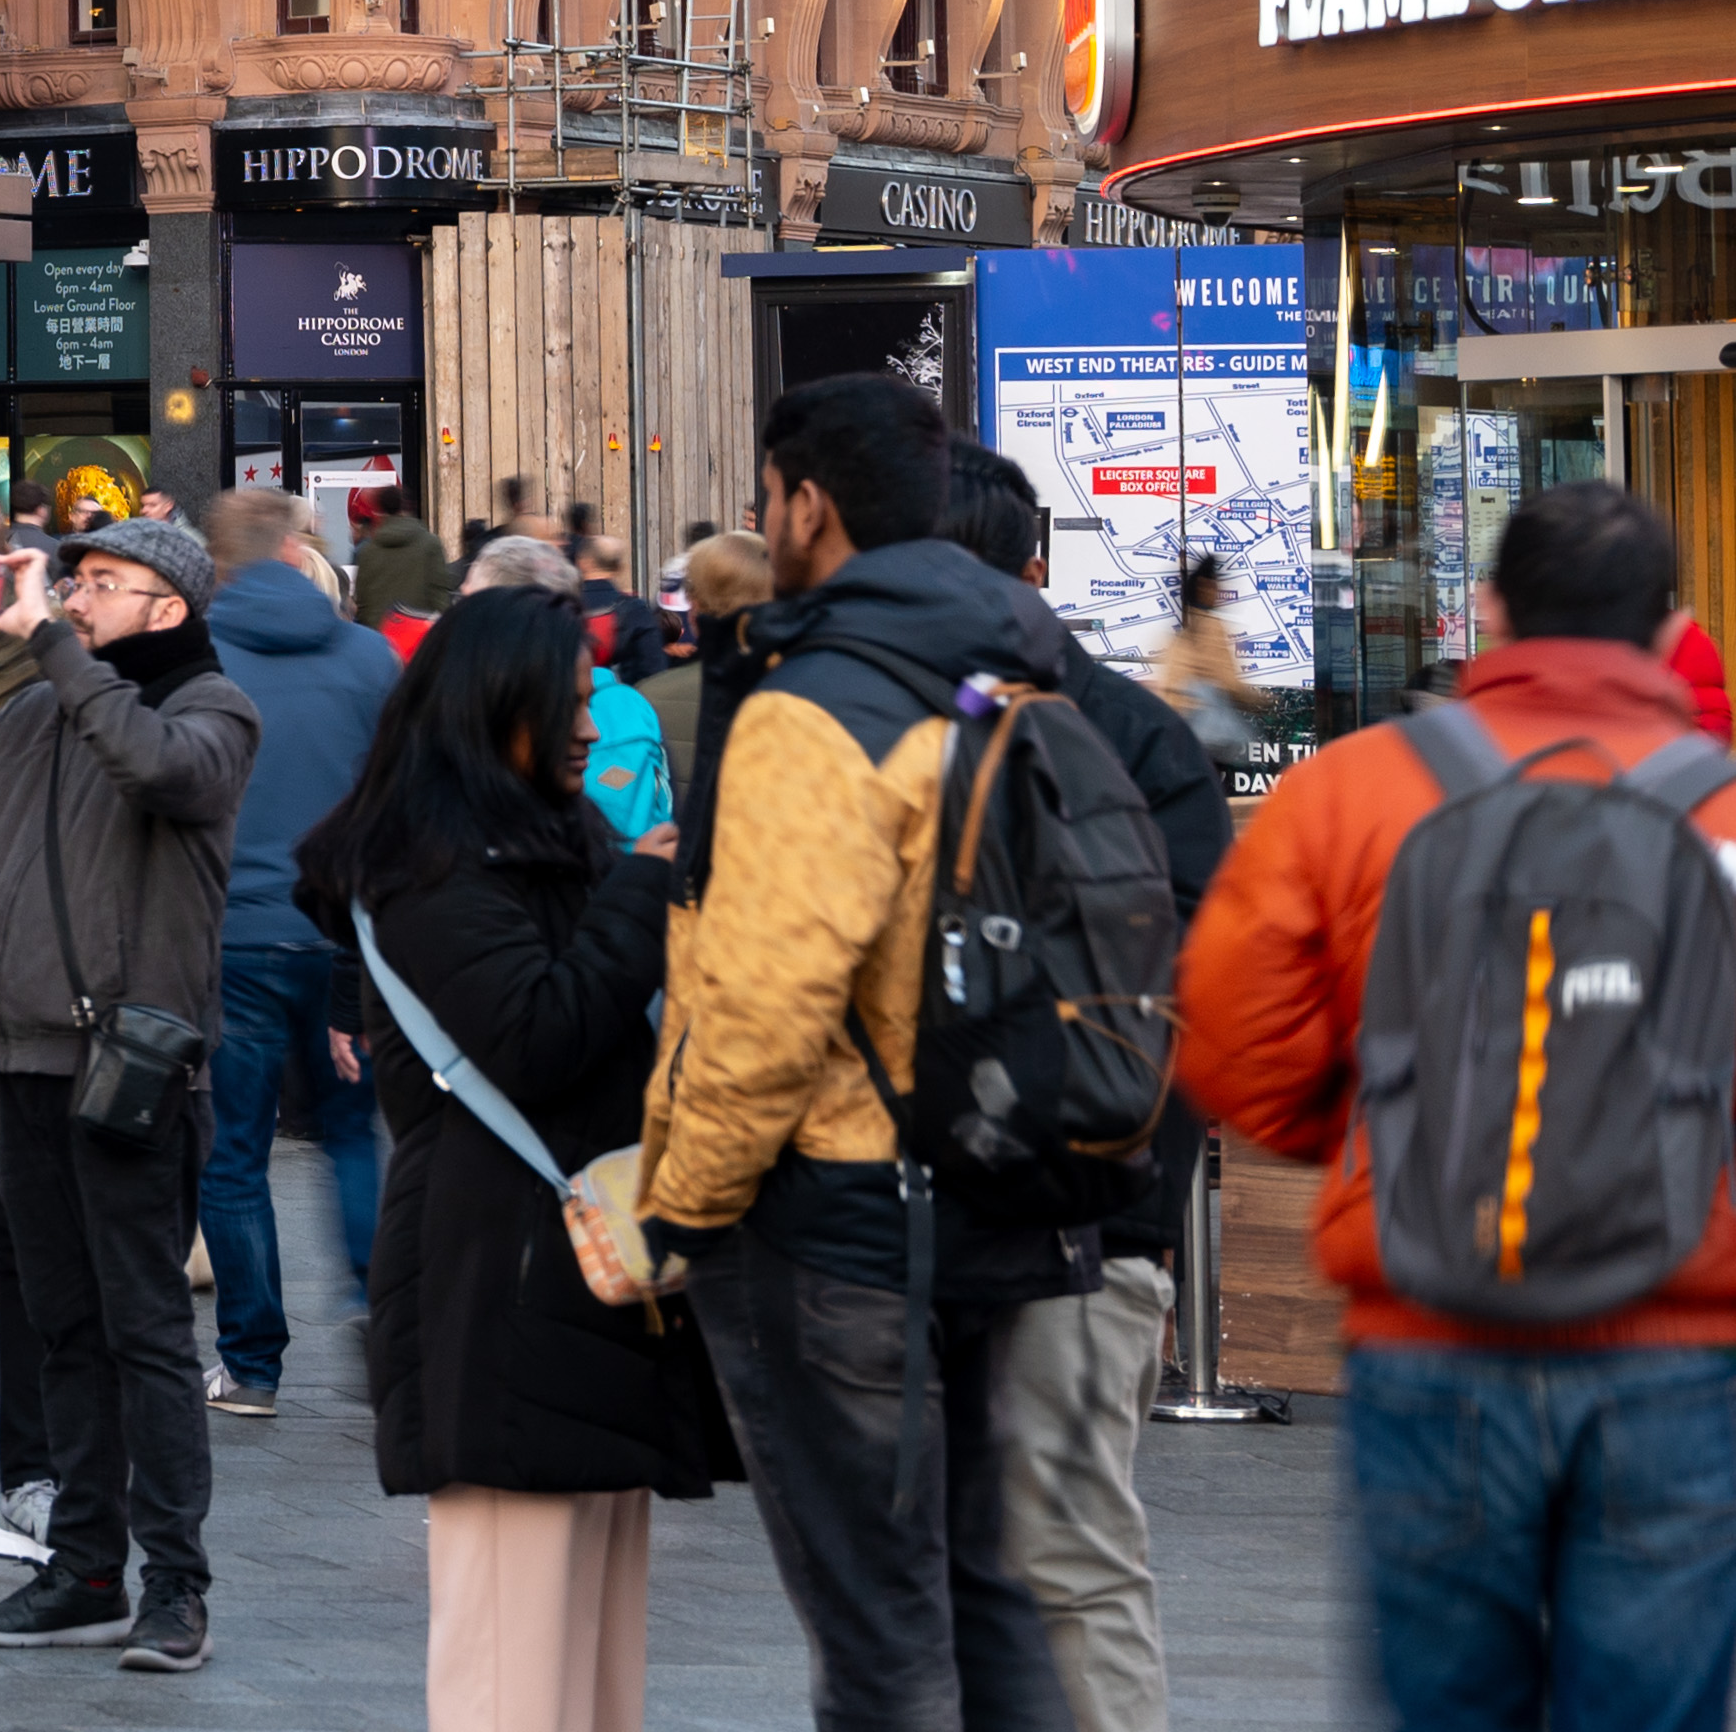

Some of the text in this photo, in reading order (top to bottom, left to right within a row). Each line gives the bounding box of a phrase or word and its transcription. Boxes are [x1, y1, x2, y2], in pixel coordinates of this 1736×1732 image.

[242, 145, 484, 182] HIPPODROME
[880, 180, 978, 233] CASINO
[44, 261, 124, 280] Open every day
[55, 282, 79, 298] 6pm
[89, 280, 113, 293] 4am
[1174, 277, 1299, 306] WELCOME
[34, 297, 136, 313] Lower Ground Floor
[343, 307, 358, 315] THE
[1276, 310, 1302, 321] THE
[45, 317, 124, 334] 每日營業時間
[298, 317, 405, 331] HIPPODROME
[321, 332, 381, 346] CASINO
[56, 338, 79, 354] 6pm
[89, 337, 113, 349] 4am
[334, 348, 369, 356] LONDON
[59, 353, 111, 370] 地下一層
[1026, 357, 1072, 374] WEST
[1078, 356, 1115, 373] END
[1120, 355, 1215, 373] THEATRES
[1229, 354, 1286, 372] GUIDE
[1232, 382, 1260, 390] Street
[1074, 392, 1105, 400] Oxford
[1017, 410, 1054, 419] Oxford
[1017, 419, 1052, 428] Circus
[1109, 421, 1162, 429] PALLADIUM
[1099, 468, 1206, 481] LEICESTER SQUARE
[1120, 481, 1190, 493] BOX OFFICE
[1215, 543, 1242, 551] LYRIC
[1090, 579, 1146, 589] Piccadilly
[1258, 575, 1307, 583] PRINCE OF
[1090, 589, 1127, 597] Circus
[1253, 642, 1271, 650] HIS
[1236, 649, 1289, 658] MAJESTY'S
